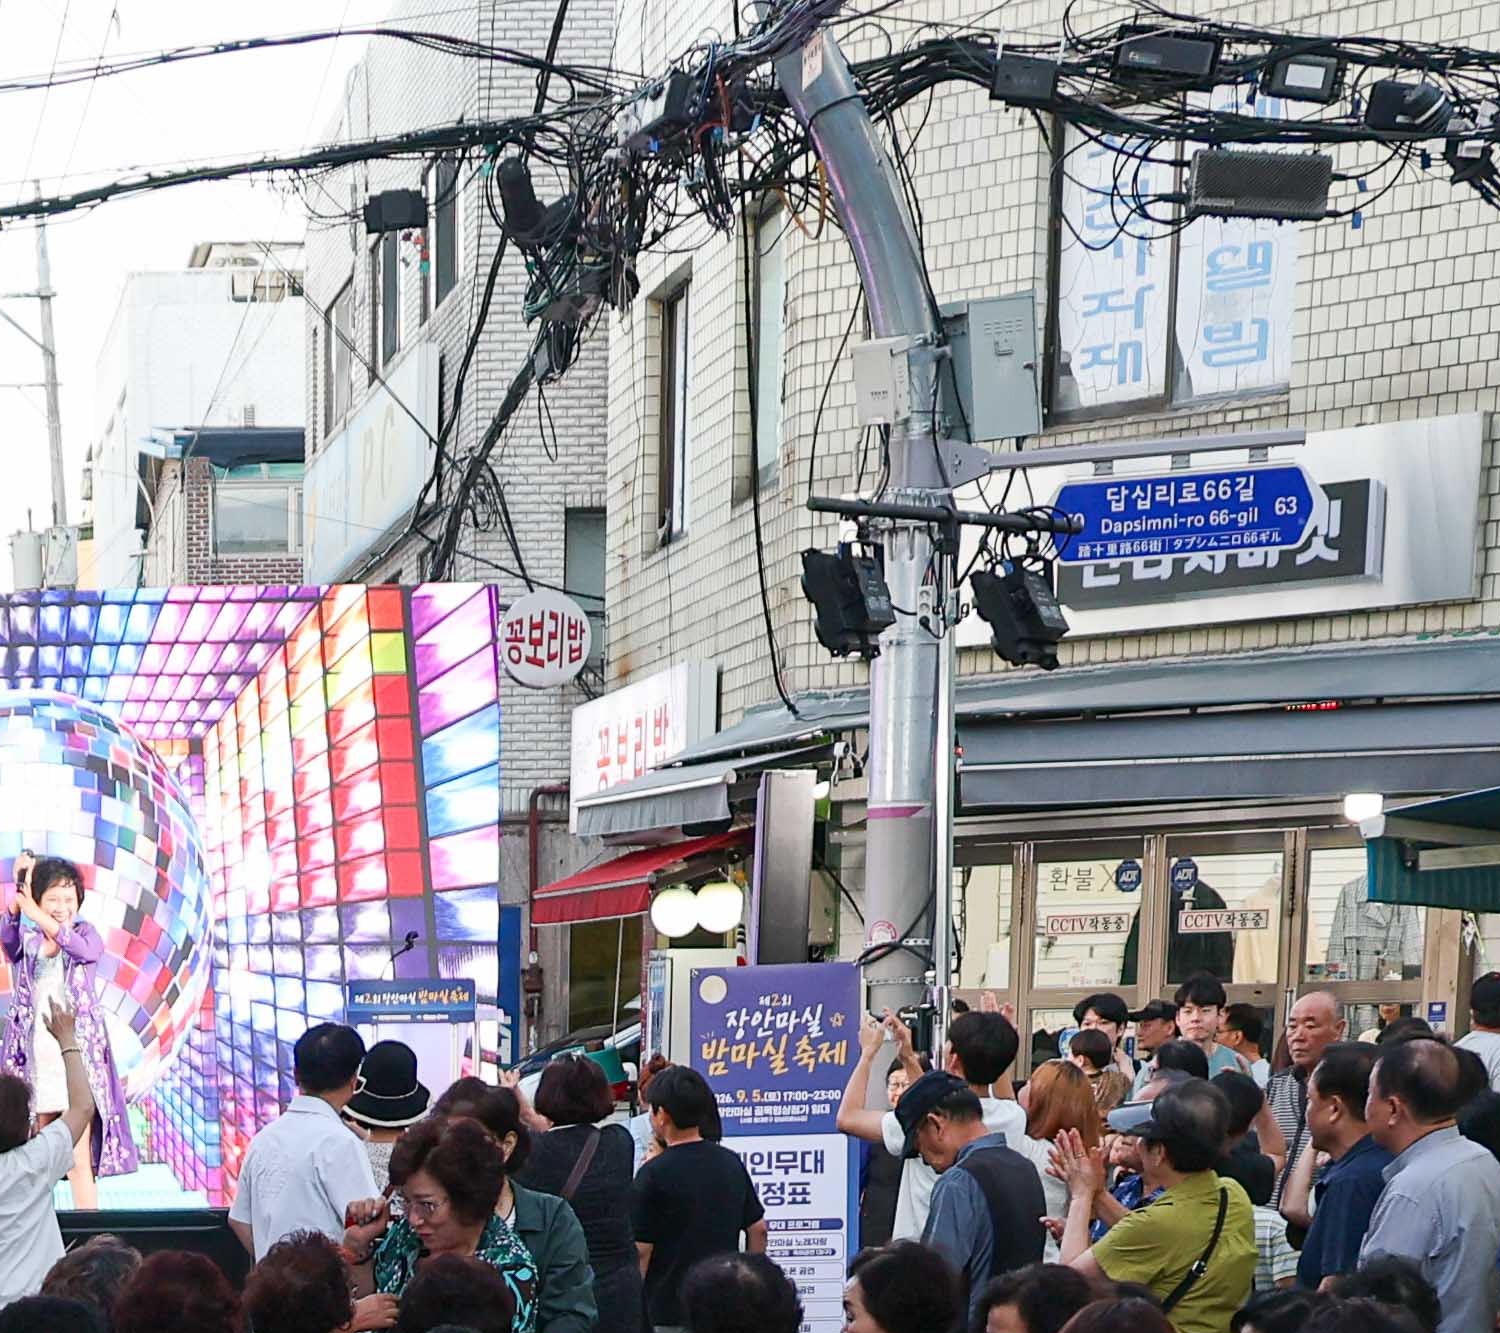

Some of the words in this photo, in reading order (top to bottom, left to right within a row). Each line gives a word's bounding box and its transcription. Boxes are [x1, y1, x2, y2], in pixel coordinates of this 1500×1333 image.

[1105, 475, 1256, 513] 답십리로66길
[1274, 497, 1298, 515] 63
[1101, 514, 1205, 537] Dapsimni-ro
[1209, 508, 1259, 531] 66-gil
[504, 609, 586, 669] 꽁보리밥
[1119, 871, 1138, 883] ADT
[1174, 869, 1194, 881] ADT
[758, 993, 792, 1007] 제2회
[726, 1003, 824, 1040] 장안마실
[783, 1089, 841, 1103] 17:00~23:00
[755, 1181, 812, 1207] 정표
